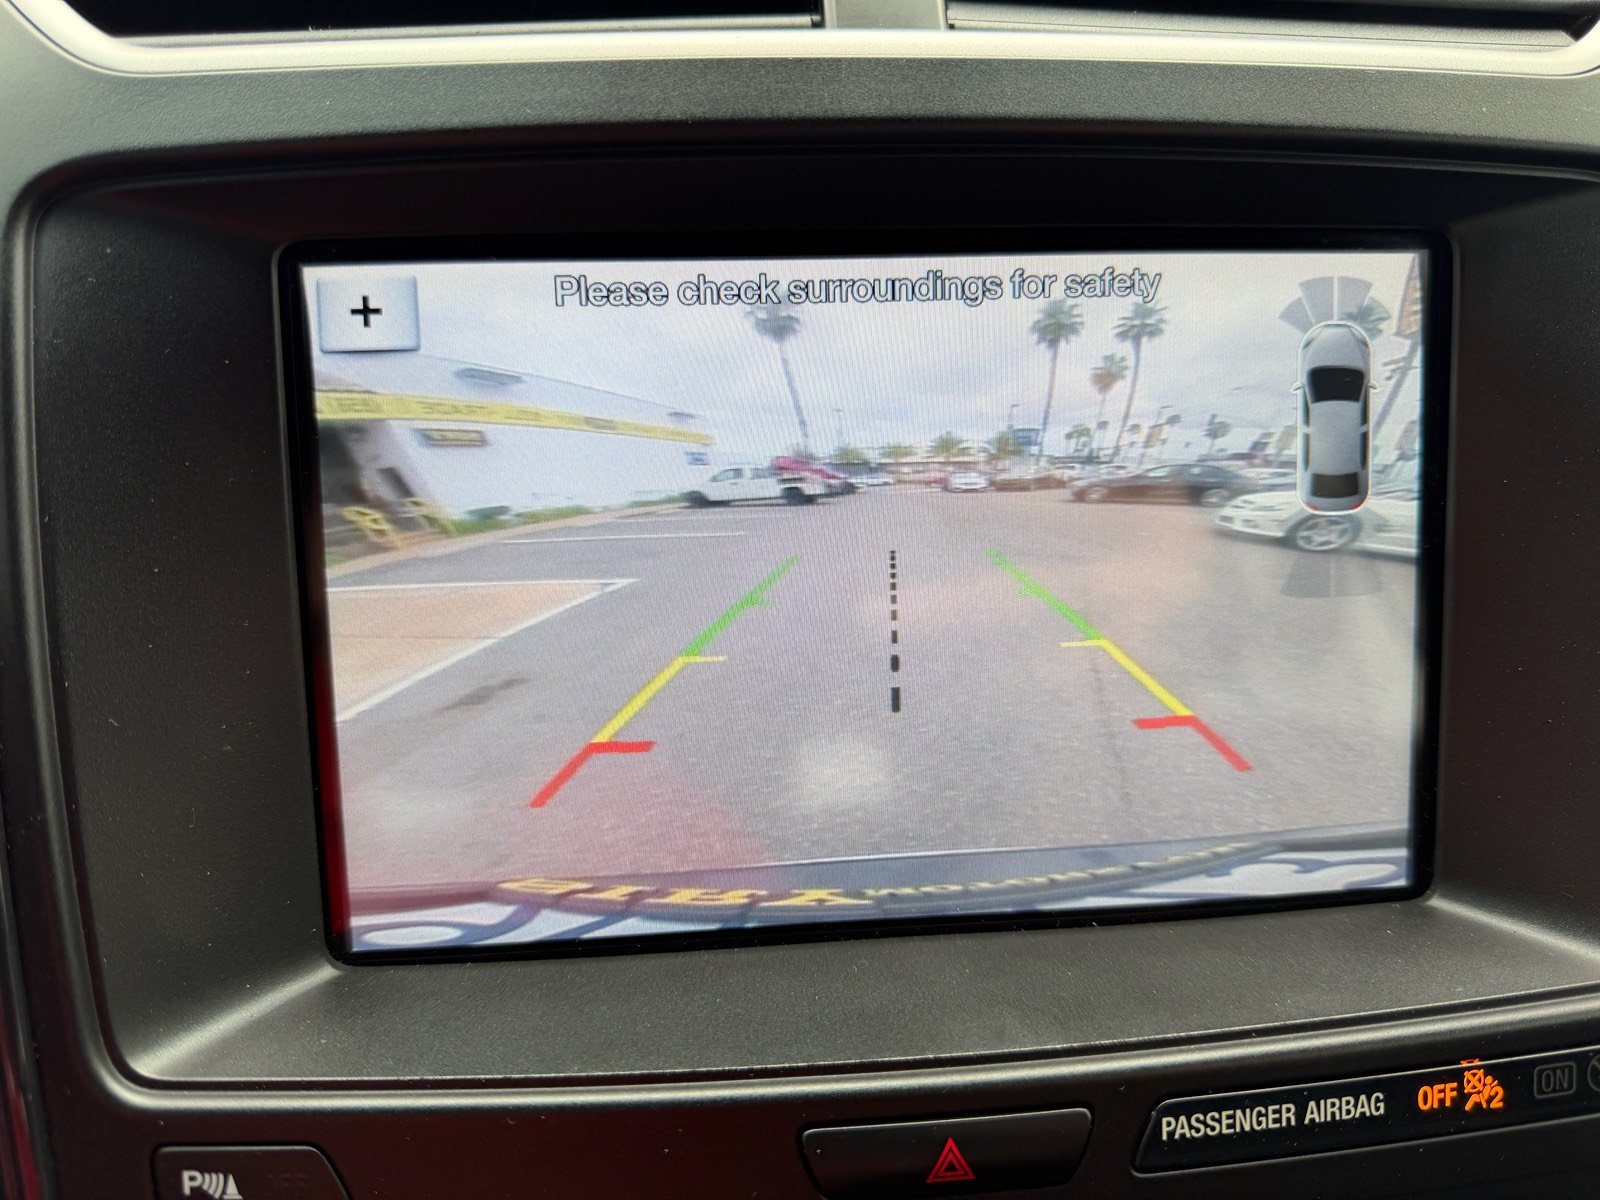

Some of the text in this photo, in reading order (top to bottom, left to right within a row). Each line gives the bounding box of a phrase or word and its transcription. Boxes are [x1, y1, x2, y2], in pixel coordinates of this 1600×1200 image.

[554, 266, 1163, 307] Please check surroundings for safety
[1541, 1068, 1569, 1093] ON
[1161, 1082, 1504, 1142] PASSENGER AIRBAG OFF 2
